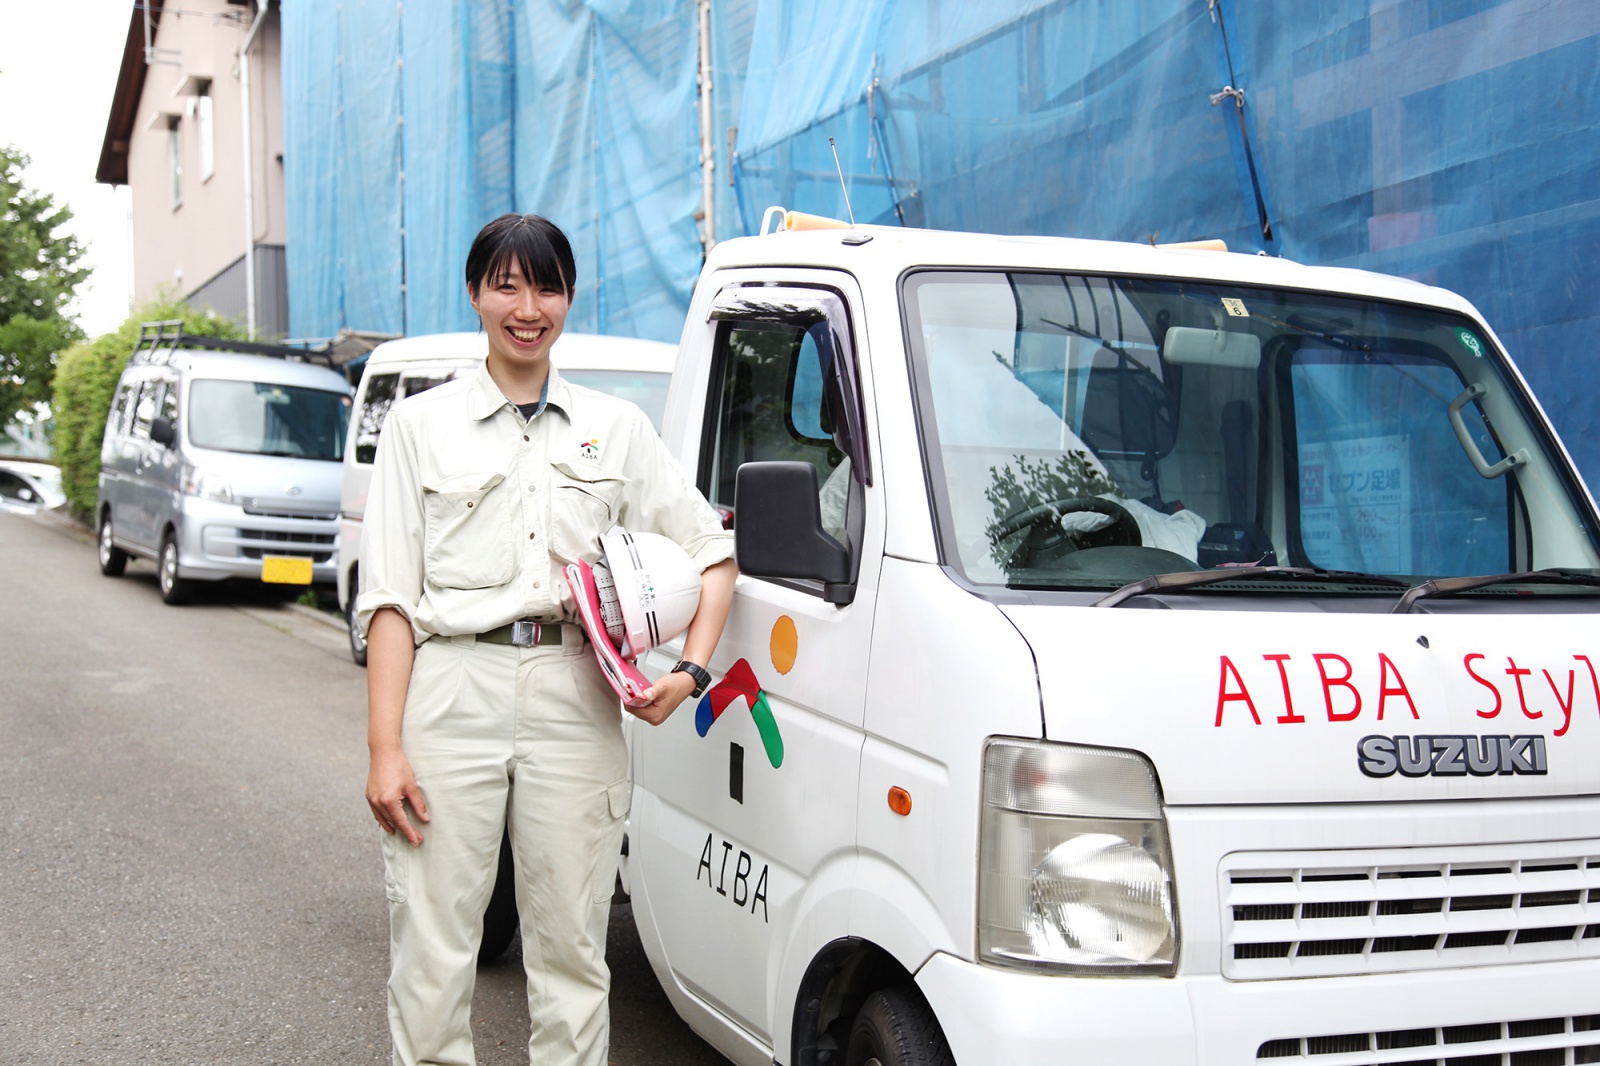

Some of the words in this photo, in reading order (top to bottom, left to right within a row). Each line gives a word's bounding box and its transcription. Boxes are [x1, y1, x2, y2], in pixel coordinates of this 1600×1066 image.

[1233, 307, 1242, 316] 6
[581, 452, 598, 461] AIBA
[1214, 653, 1420, 727] AIBA
[1358, 735, 1548, 778] SUZUKI
[697, 833, 768, 923] AIBA
